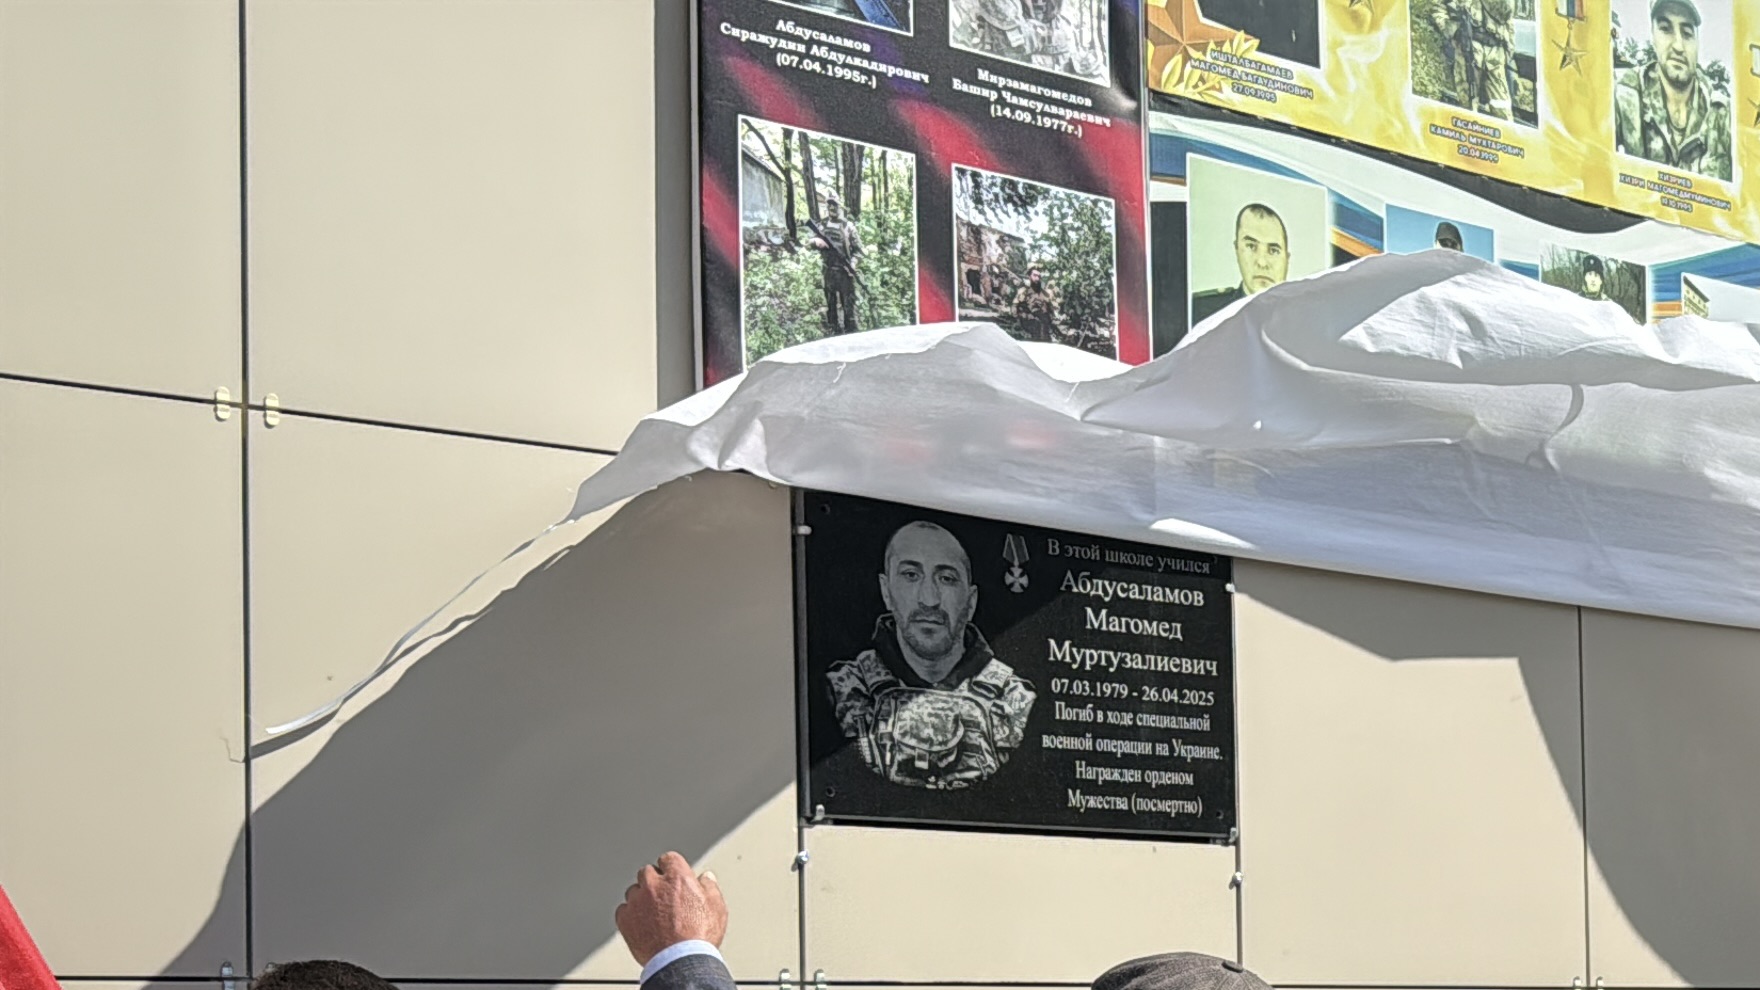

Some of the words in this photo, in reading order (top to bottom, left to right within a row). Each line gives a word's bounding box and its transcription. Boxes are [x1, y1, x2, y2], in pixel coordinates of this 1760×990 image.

[720, 22, 806, 53] Сиражудин
[810, 44, 930, 84] Абдулкадирович
[776, 19, 871, 53] Абдусаламов
[776, 52, 877, 89] (07.04.1995г.)
[977, 68, 1093, 107] Мирзамагомедов
[1190, 59, 1240, 80] МАГОМЕД
[1240, 71, 1314, 99] БАГАУДИНОВИЧ
[952, 78, 998, 101] Башир
[990, 103, 1083, 139] (14.09.1977г.)
[1451, 116, 1501, 138] ГАСАЙНИЕВ
[1429, 124, 1467, 142] КАМИЛЬ
[1468, 134, 1525, 159] МУХТАРОВИЧ
[1046, 538, 1061, 556] В
[1063, 543, 1101, 561] этой
[1105, 550, 1154, 568] школе
[1157, 555, 1211, 575] учился
[1059, 569, 1205, 607] Абдусаламов
[1084, 606, 1183, 642] Магомед
[1047, 638, 1219, 677] Муртузалиевич
[1051, 677, 1129, 699] 07.03.1979
[1141, 686, 1215, 706] 26.04.2025
[1054, 701, 1094, 722] Погиб
[1096, 712, 1104, 723] в
[1106, 712, 1134, 726] ходе
[1136, 714, 1211, 732] специальной
[1042, 732, 1093, 751] военной
[1096, 738, 1153, 758] операции
[1155, 742, 1170, 756] на
[1171, 738, 1224, 762] Украине.
[1075, 760, 1142, 784] Награжден
[1144, 770, 1194, 788] орденом
[1067, 788, 1129, 812] Мужества
[1131, 792, 1203, 817] (посмертно)
